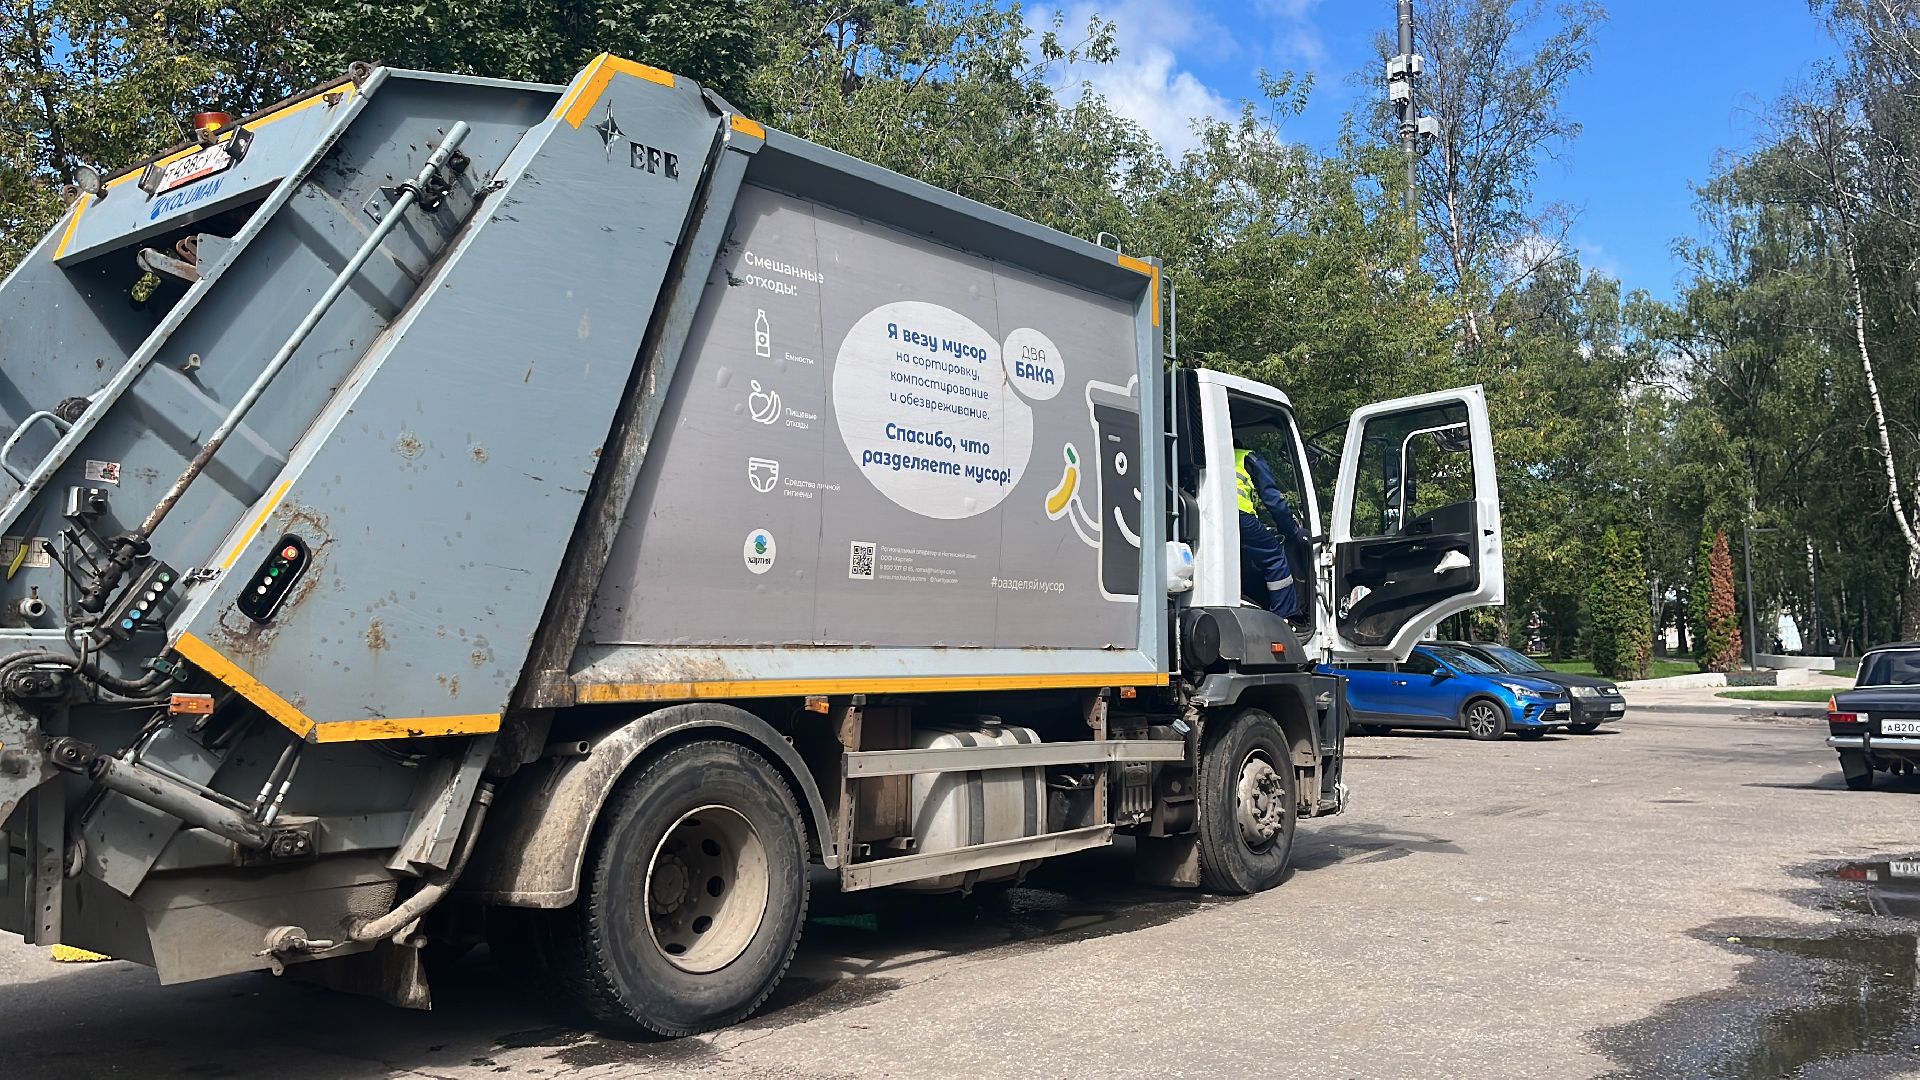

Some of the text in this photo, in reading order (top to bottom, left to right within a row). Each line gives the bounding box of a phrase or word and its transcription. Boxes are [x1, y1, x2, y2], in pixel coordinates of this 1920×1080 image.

[629, 141, 680, 181] EFE
[161, 177, 225, 214] KOLUMAN
[744, 251, 824, 284] Смешанные
[745, 274, 798, 296] отходы:
[887, 323, 987, 363] Я везу мусор
[1021, 345, 1046, 363] ДВА
[896, 351, 980, 381] на сортировку,
[1015, 361, 1055, 385] БАКА
[890, 371, 989, 400] компостирование
[890, 392, 990, 420] и обезвреживание.
[885, 422, 990, 455] Спасибо, что
[862, 449, 1011, 486] разделяете мусор!
[784, 477, 816, 489] Средства
